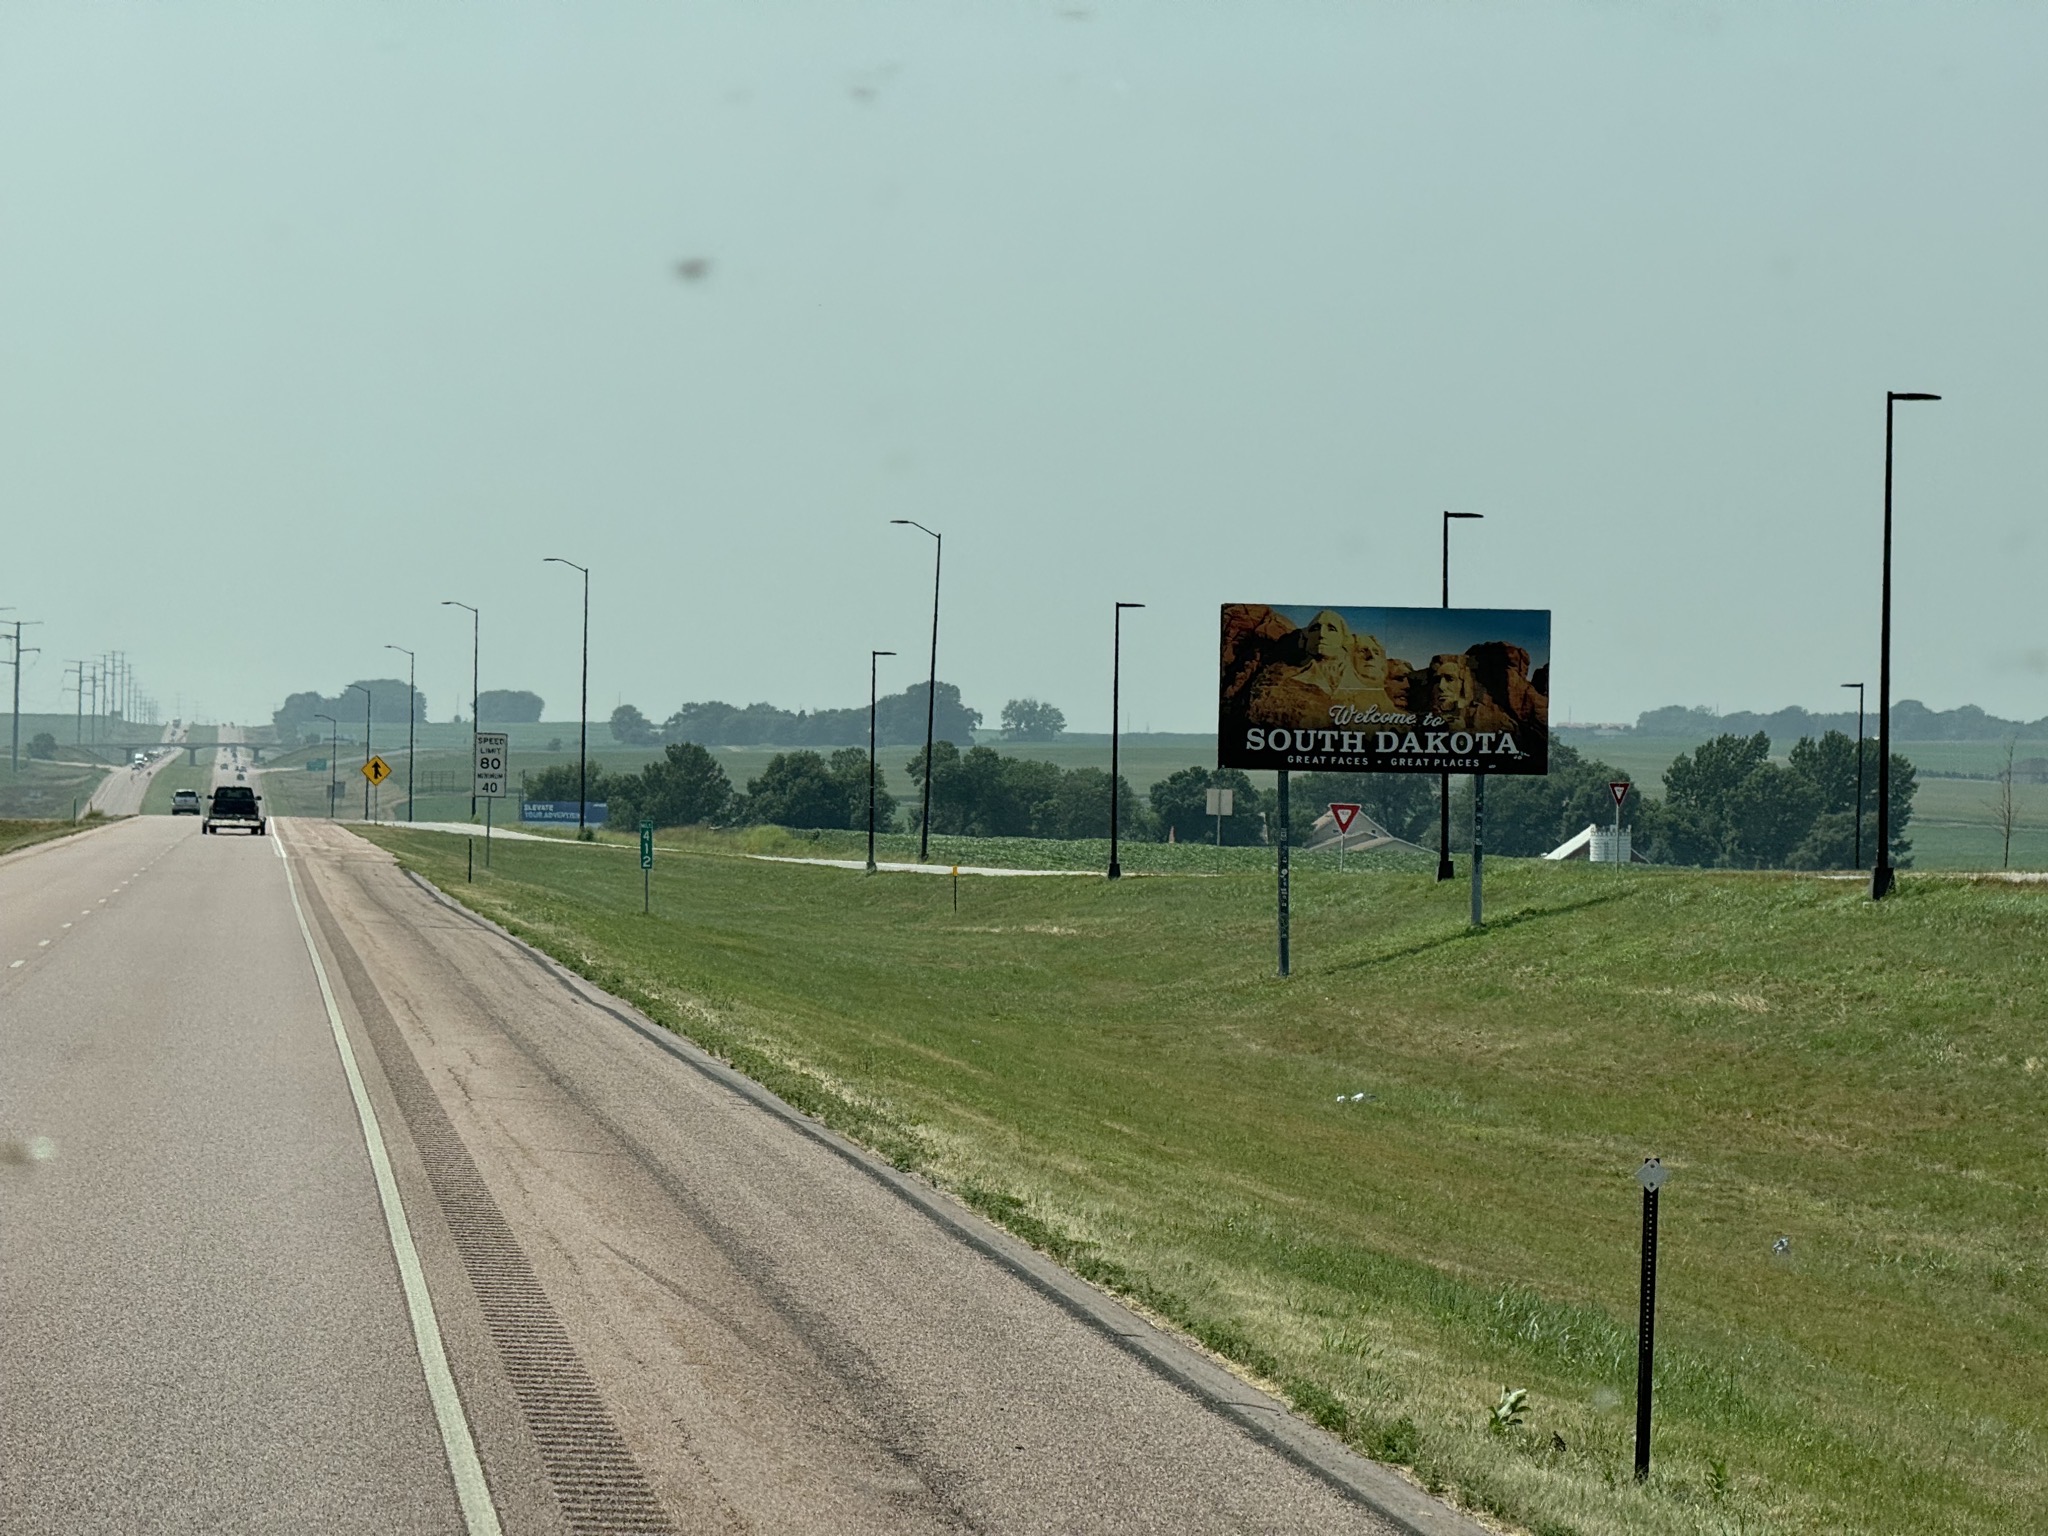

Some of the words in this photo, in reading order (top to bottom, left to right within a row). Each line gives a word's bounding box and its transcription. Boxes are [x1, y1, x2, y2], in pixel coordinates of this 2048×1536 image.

[1329, 703, 1418, 726] Welcome
[1423, 711, 1446, 727] to
[478, 737, 505, 746] SPEED
[1246, 728, 1366, 753] SOUTH
[1375, 731, 1519, 755] DAKOTA
[480, 747, 501, 755] LIMIT
[479, 757, 501, 770] 80
[1287, 755, 1327, 764] GREAT
[1331, 756, 1369, 766] FACES
[1391, 758, 1430, 767] GREAT
[1434, 759, 1479, 767] PLACES
[482, 782, 497, 793] 40
